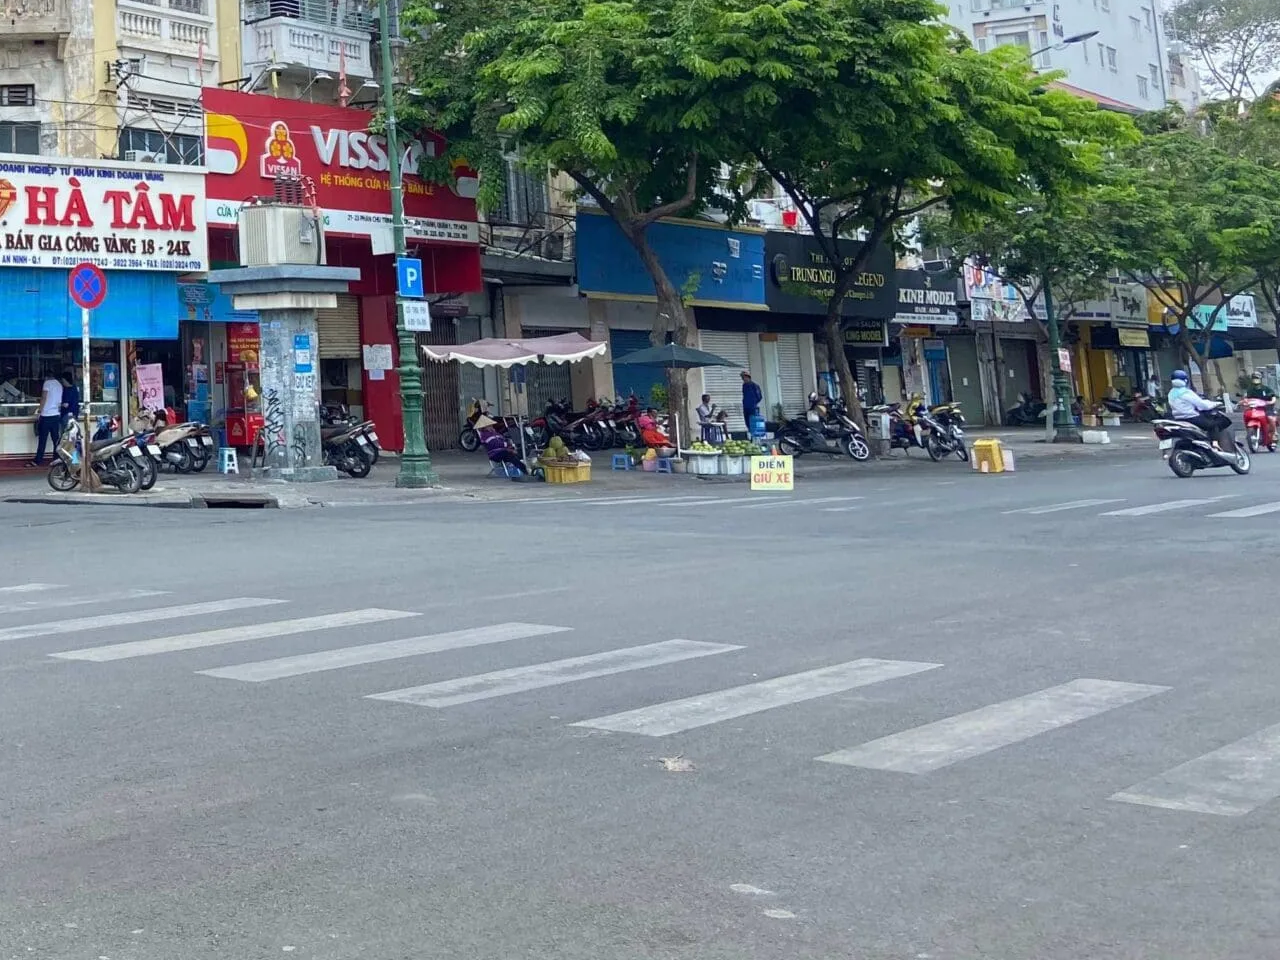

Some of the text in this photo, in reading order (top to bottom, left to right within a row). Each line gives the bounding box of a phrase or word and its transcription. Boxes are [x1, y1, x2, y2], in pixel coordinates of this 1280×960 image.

[28, 164, 57, 177] NGHIỆP
[60, 165, 71, 176] TƯ
[74, 166, 94, 177] NHÂN
[97, 169, 114, 178] KINH
[117, 170, 143, 180] DOANH
[145, 170, 164, 181] VÀNG
[320, 173, 331, 187] HỆ
[334, 173, 362, 187] THỐNG
[24, 177, 196, 232] HÀ TÂM
[5, 229, 34, 250] BÁN
[38, 234, 62, 251] GIA
[103, 233, 136, 254] VÀNG
[141, 239, 155, 255] 18
[167, 240, 191, 256] 24K
[2, 255, 10, 263] AN
[13, 255, 27, 264] NINH
[406, 267, 417, 288] P
[791, 267, 818, 282] TRUNG
[926, 290, 956, 306] MODEL
[776, 472, 790, 483] XE
